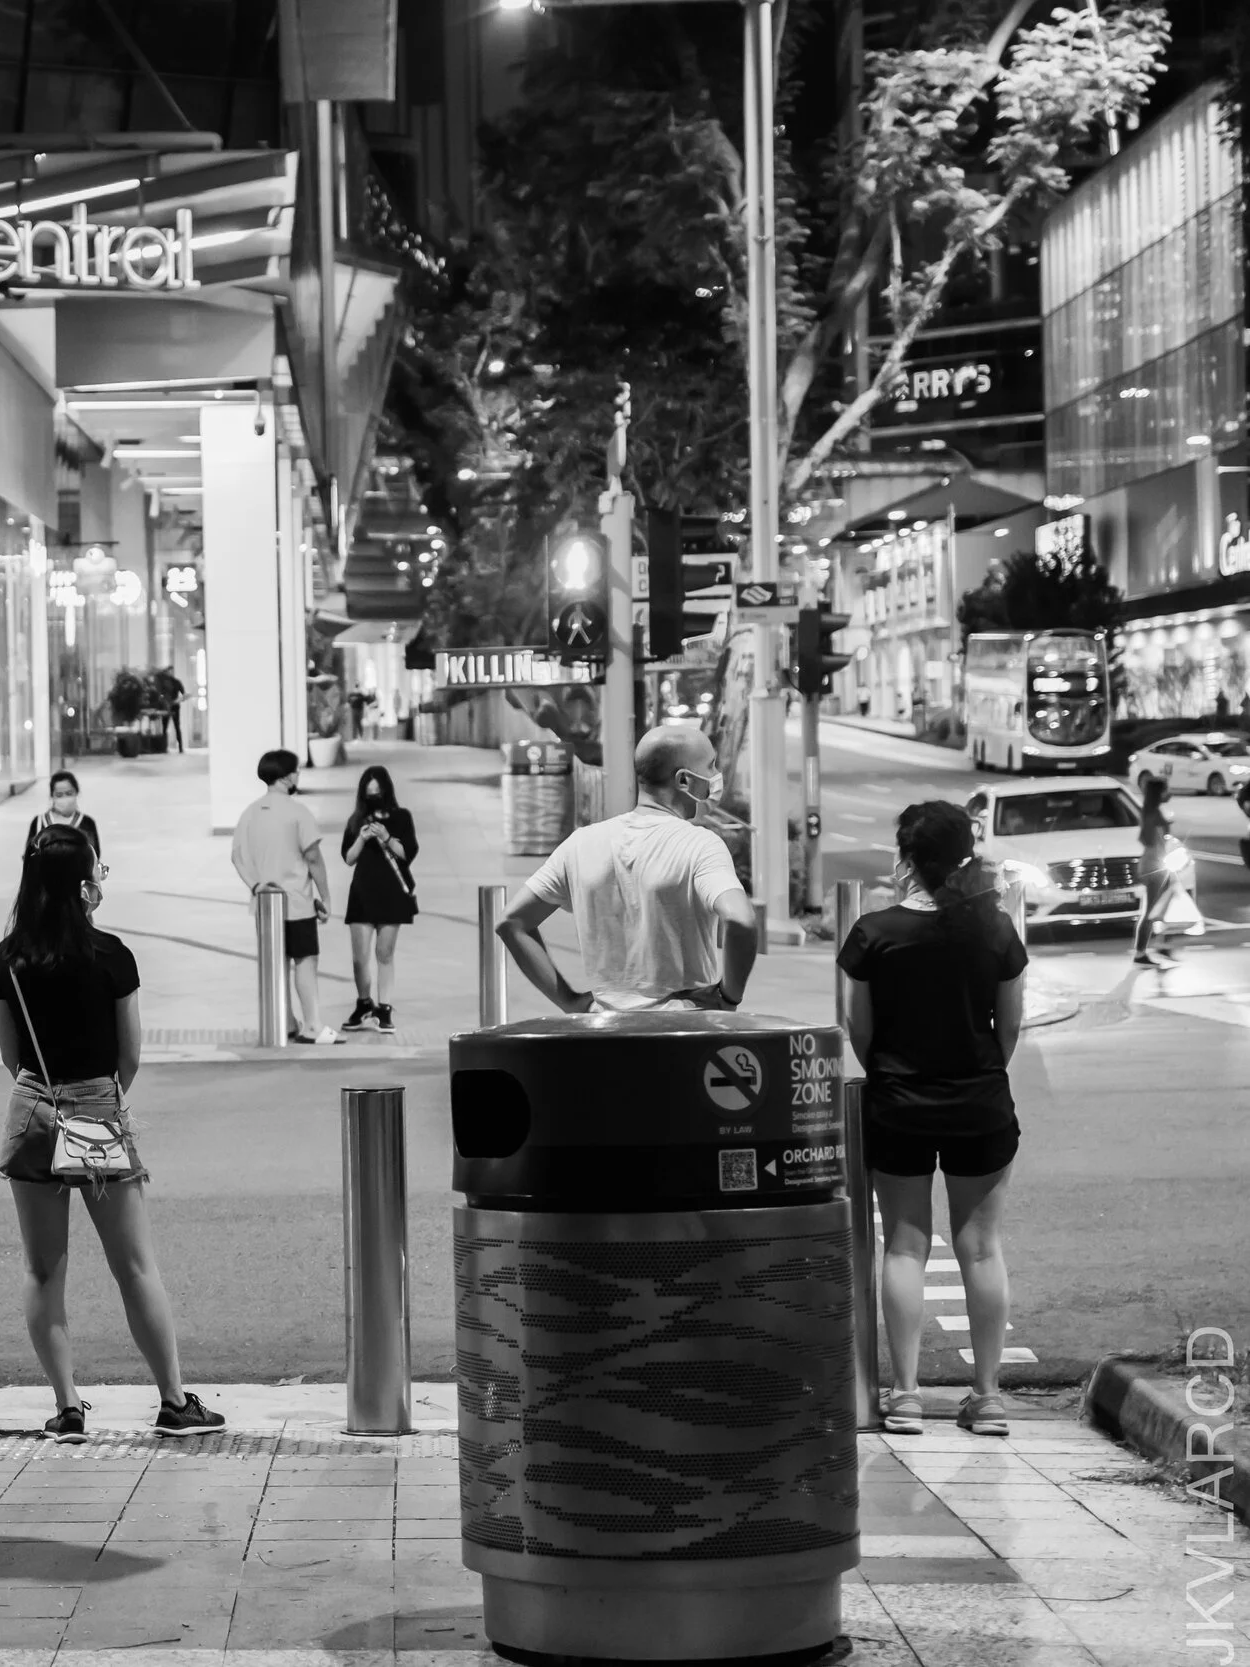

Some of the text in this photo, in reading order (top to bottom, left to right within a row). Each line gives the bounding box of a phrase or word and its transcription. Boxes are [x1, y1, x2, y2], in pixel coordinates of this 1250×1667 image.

[894, 363, 992, 399] RRY'S
[790, 1033, 816, 1055] NO
[791, 1057, 844, 1080] SMOKIN
[791, 1082, 832, 1105] ZONE
[719, 1125, 752, 1135] BY LAW
[783, 1145, 835, 1164] ORCHARD
